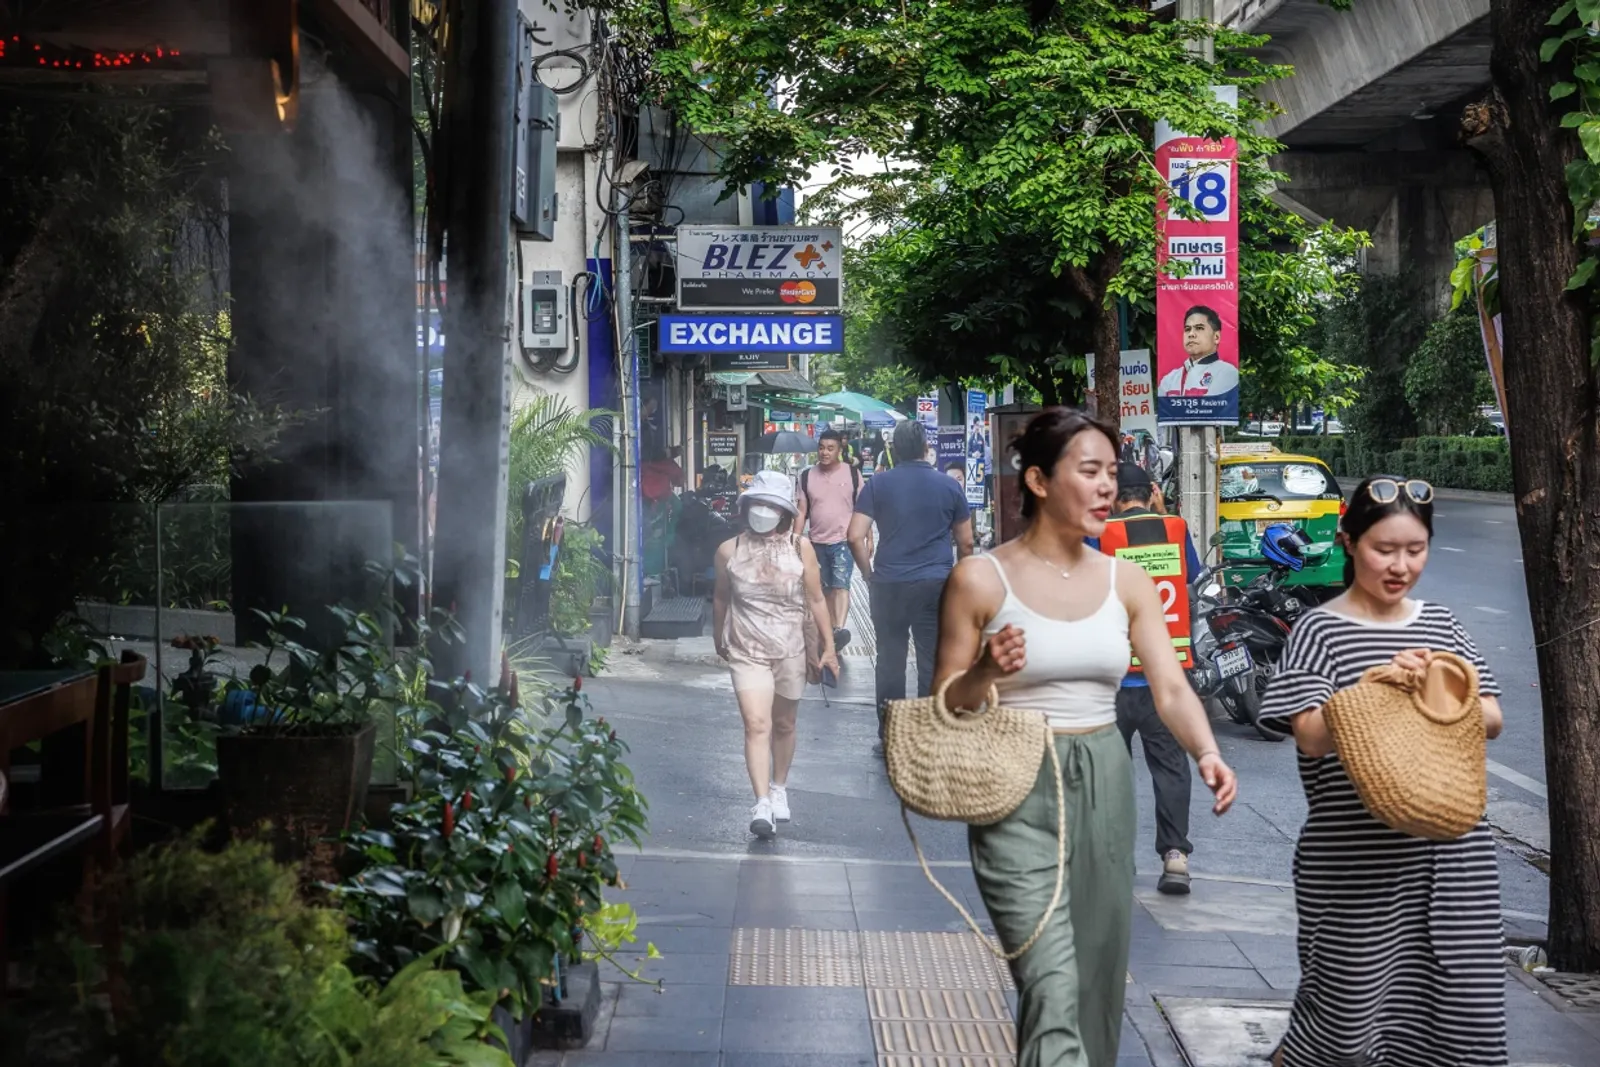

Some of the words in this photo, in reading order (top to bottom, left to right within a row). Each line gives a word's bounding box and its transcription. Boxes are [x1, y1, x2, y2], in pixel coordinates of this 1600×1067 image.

[1170, 172, 1228, 217] 18
[1171, 242, 1224, 255] เกษตร
[702, 244, 796, 270] BLEZ
[701, 271, 832, 279] PHARMACY
[741, 288, 754, 296] We
[755, 288, 776, 296] Prefer
[670, 322, 832, 345] EXCHANGE
[918, 402, 933, 412] 32
[1119, 400, 1138, 417] ท้า
[1170, 398, 1199, 409] วราวุธ
[976, 462, 985, 484] 5
